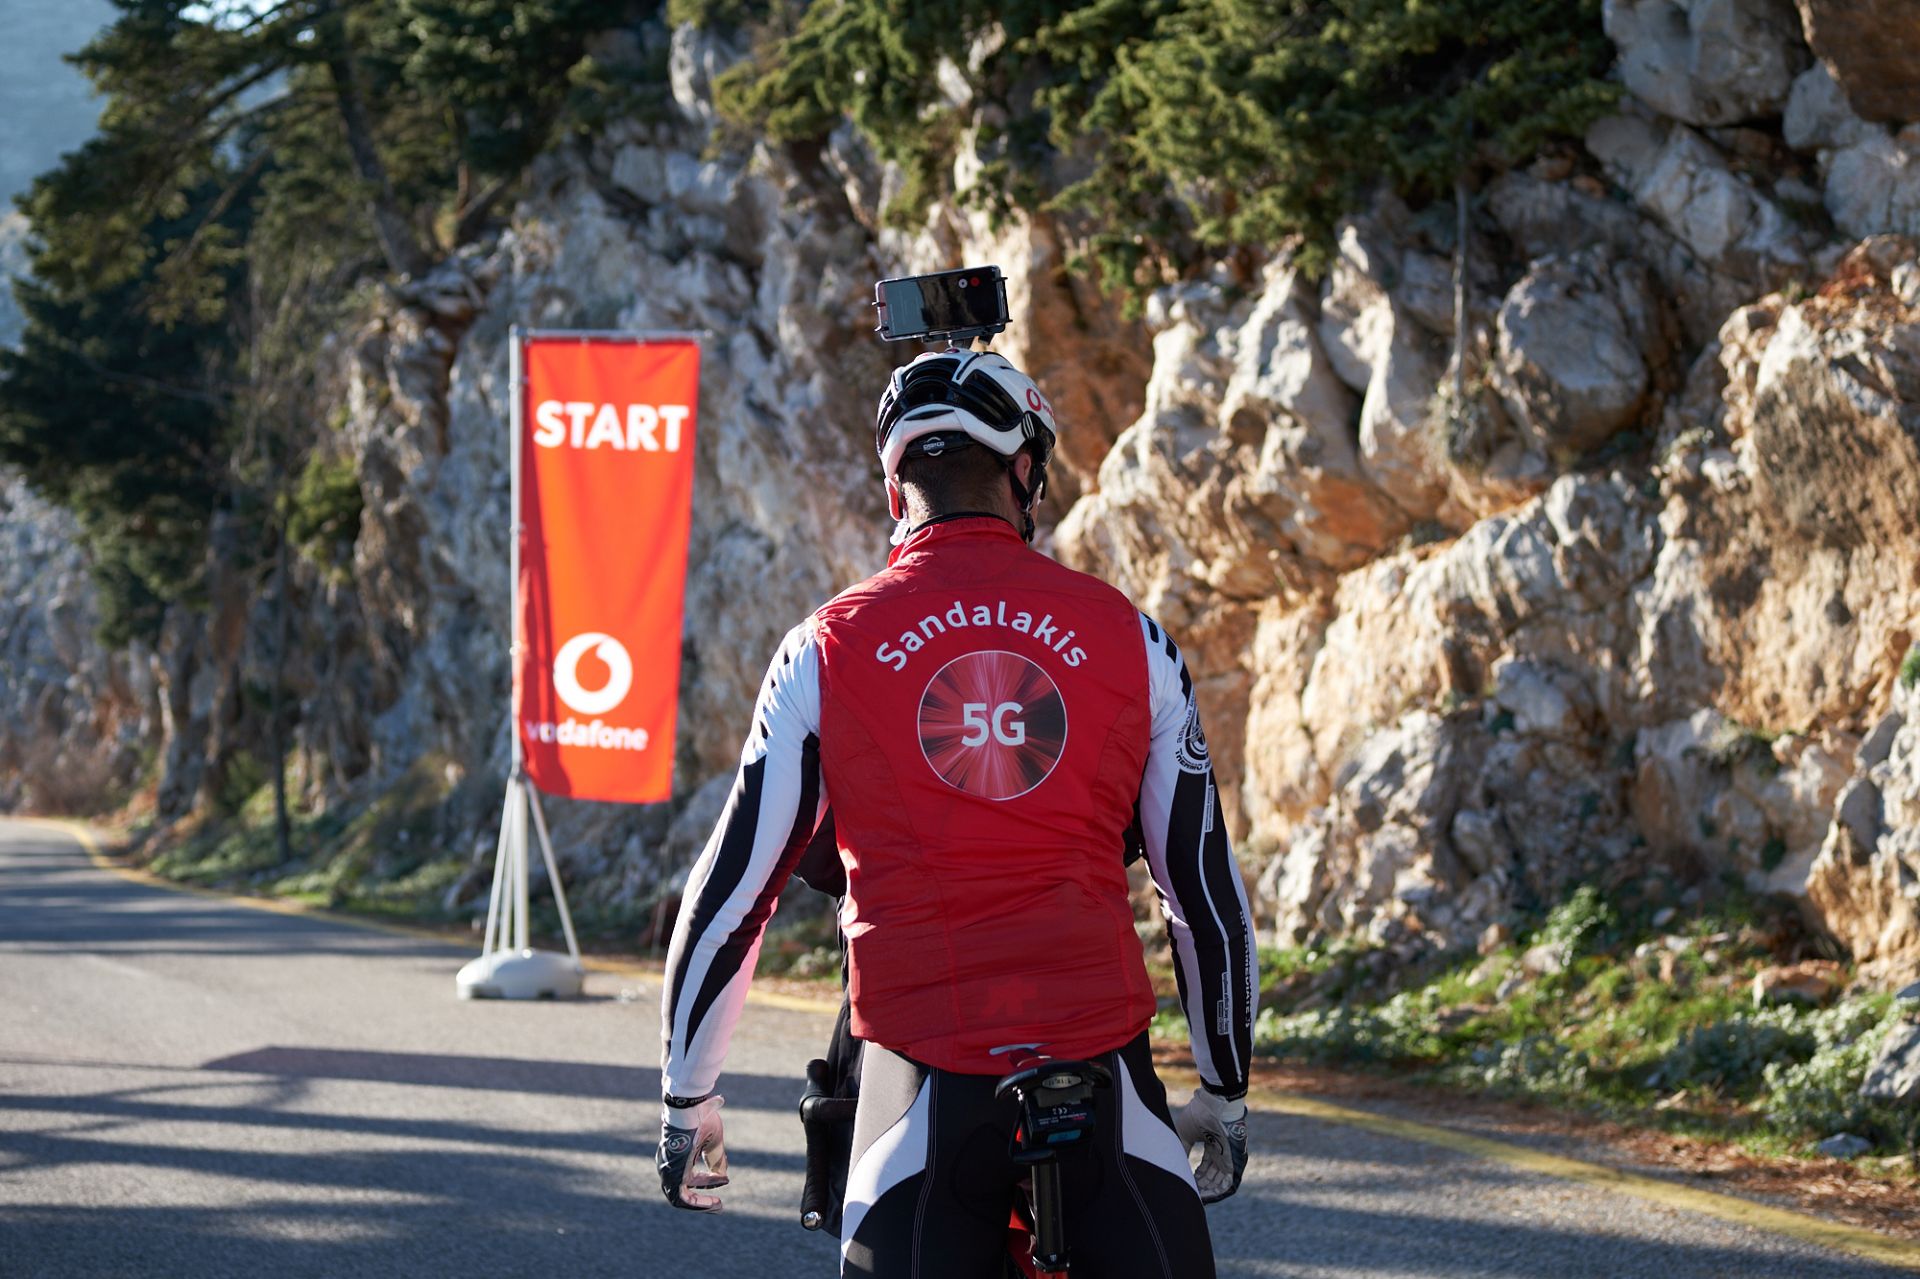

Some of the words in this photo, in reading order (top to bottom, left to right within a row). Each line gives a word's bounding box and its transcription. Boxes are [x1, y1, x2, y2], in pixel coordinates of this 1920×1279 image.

[533, 400, 689, 452] START
[876, 601, 1088, 672] Sandalakis
[524, 717, 649, 751] vodafone
[961, 702, 1026, 747] 5G
